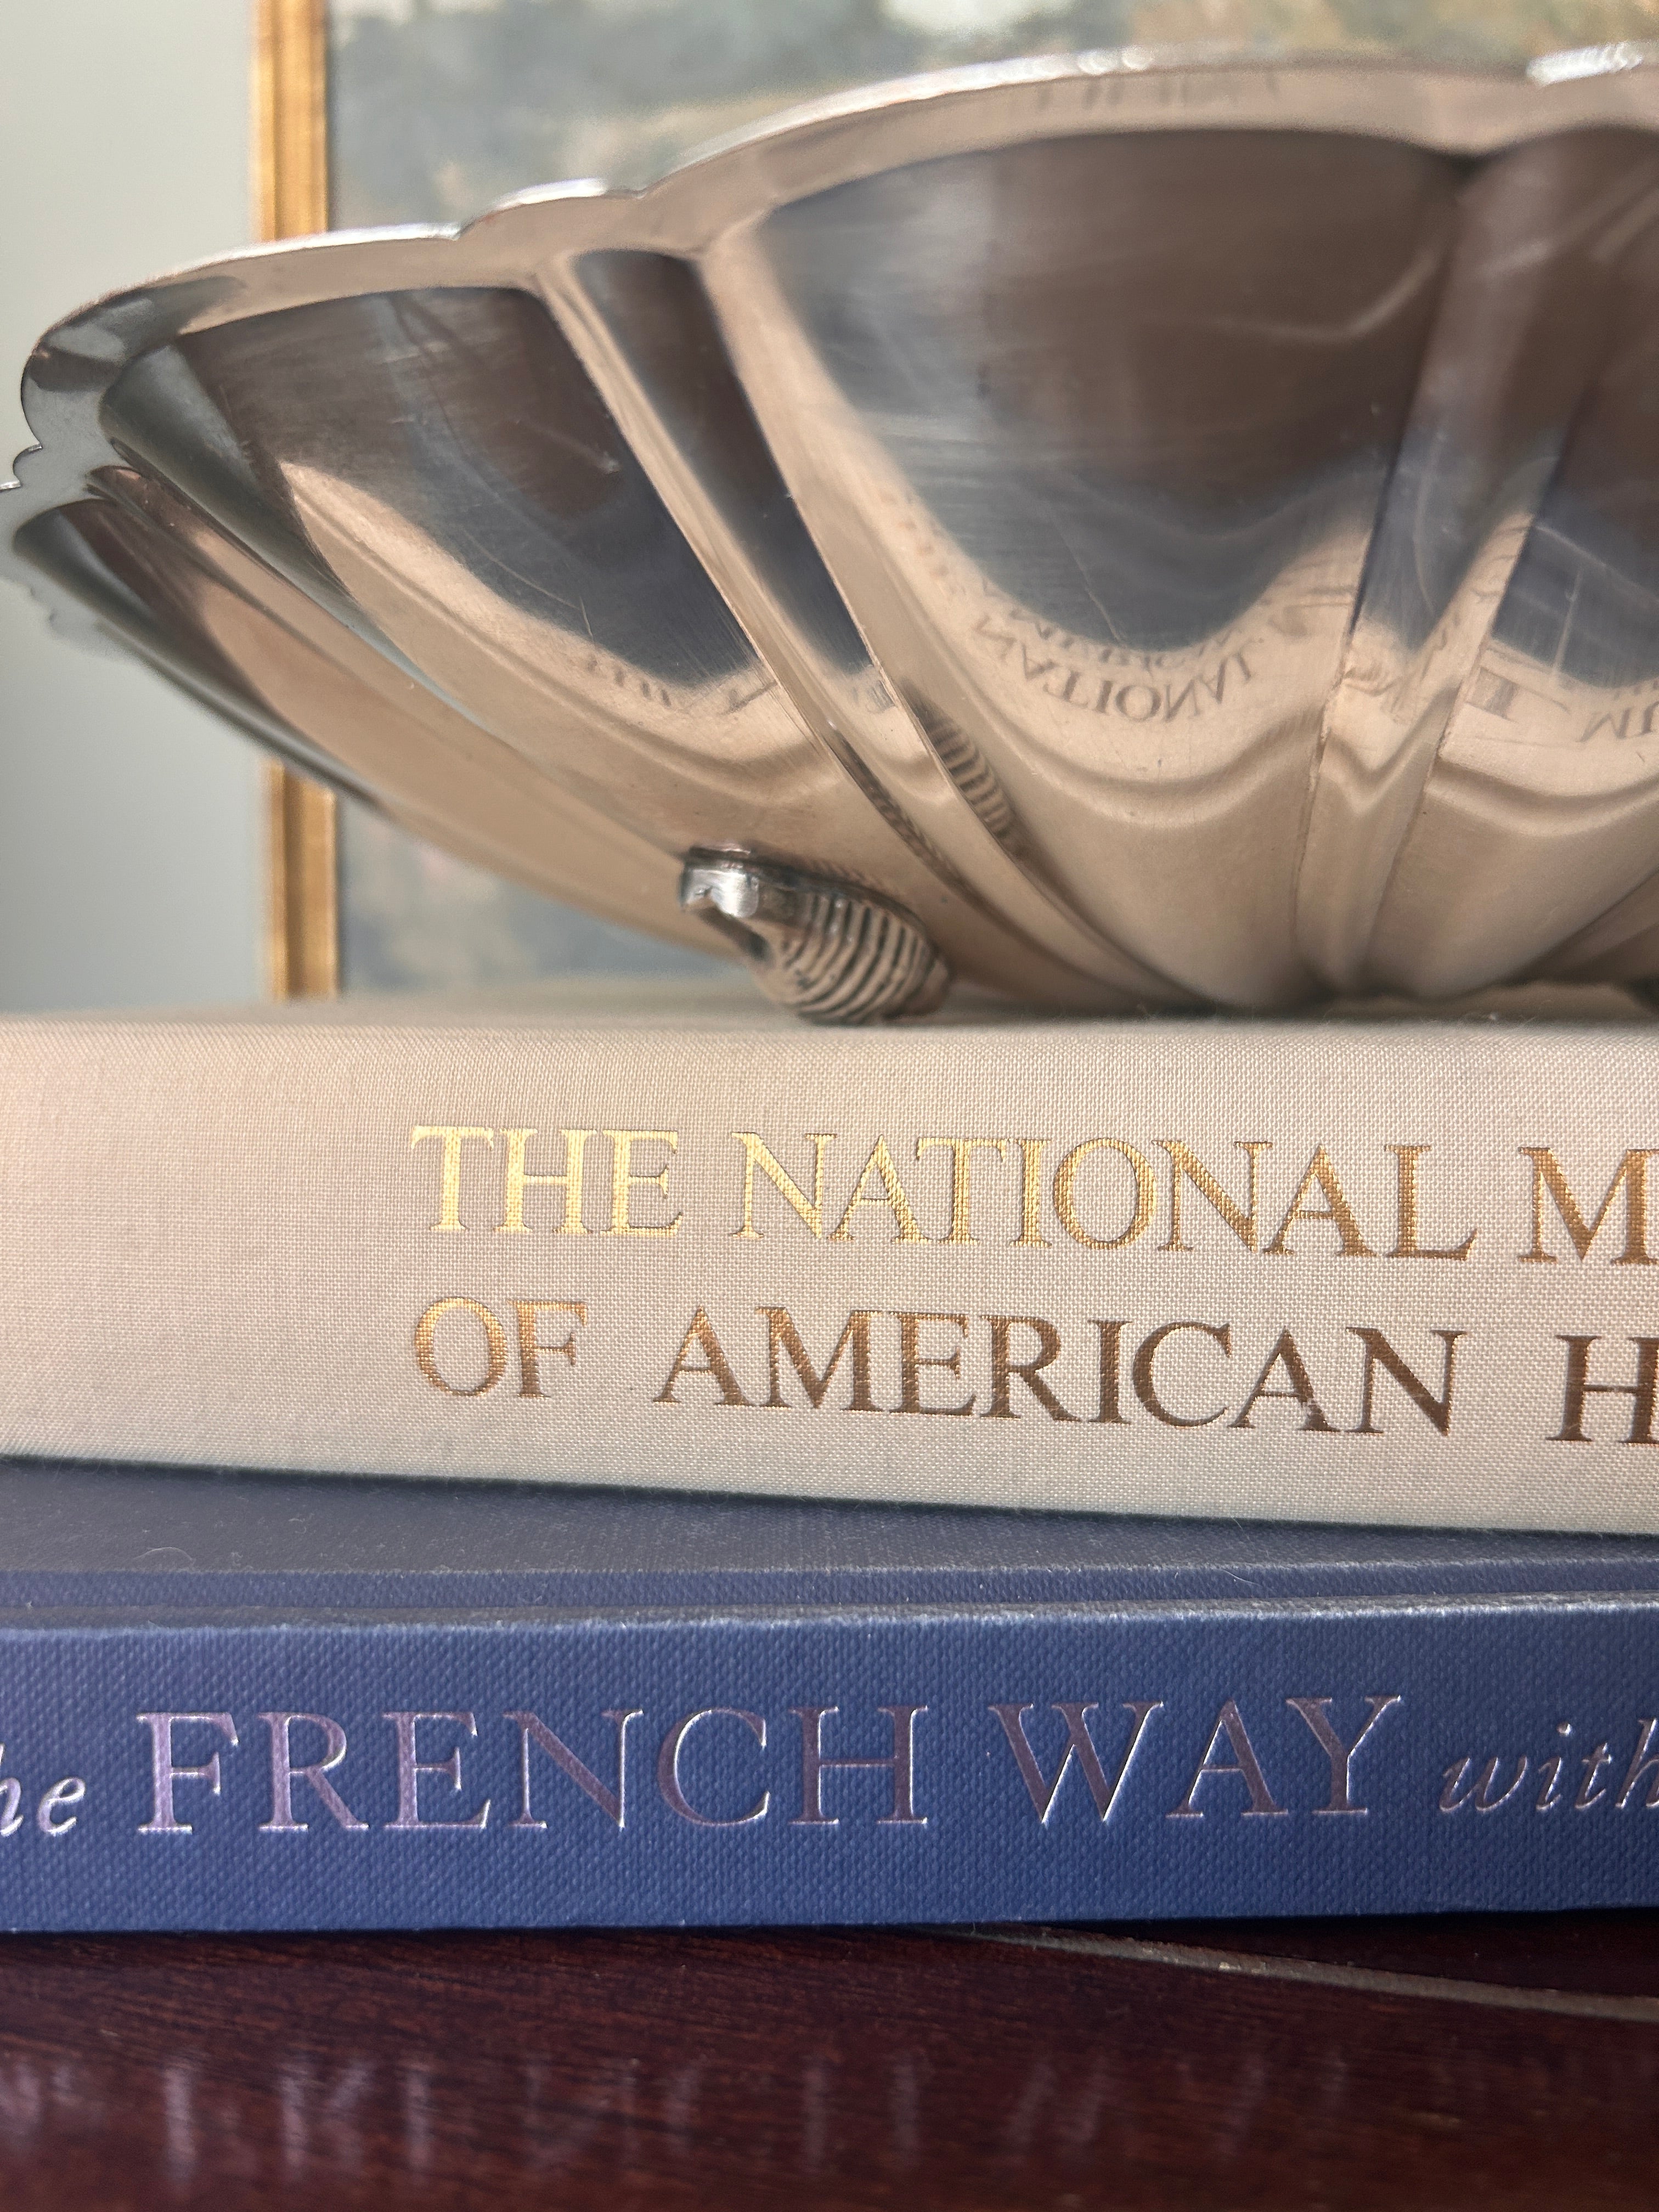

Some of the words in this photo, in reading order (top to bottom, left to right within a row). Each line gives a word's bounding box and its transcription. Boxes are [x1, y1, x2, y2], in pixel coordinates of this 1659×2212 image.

[411, 1125, 684, 1239] THE
[730, 1132, 1478, 1262] NATIONAL
[1517, 1146, 1659, 1265] M
[413, 1296, 588, 1400] OF
[651, 1304, 1468, 1438] AMERICAN
[1544, 1335, 1659, 1446] H
[136, 1706, 929, 1833] FRENCH
[988, 1694, 1402, 1826] WAY
